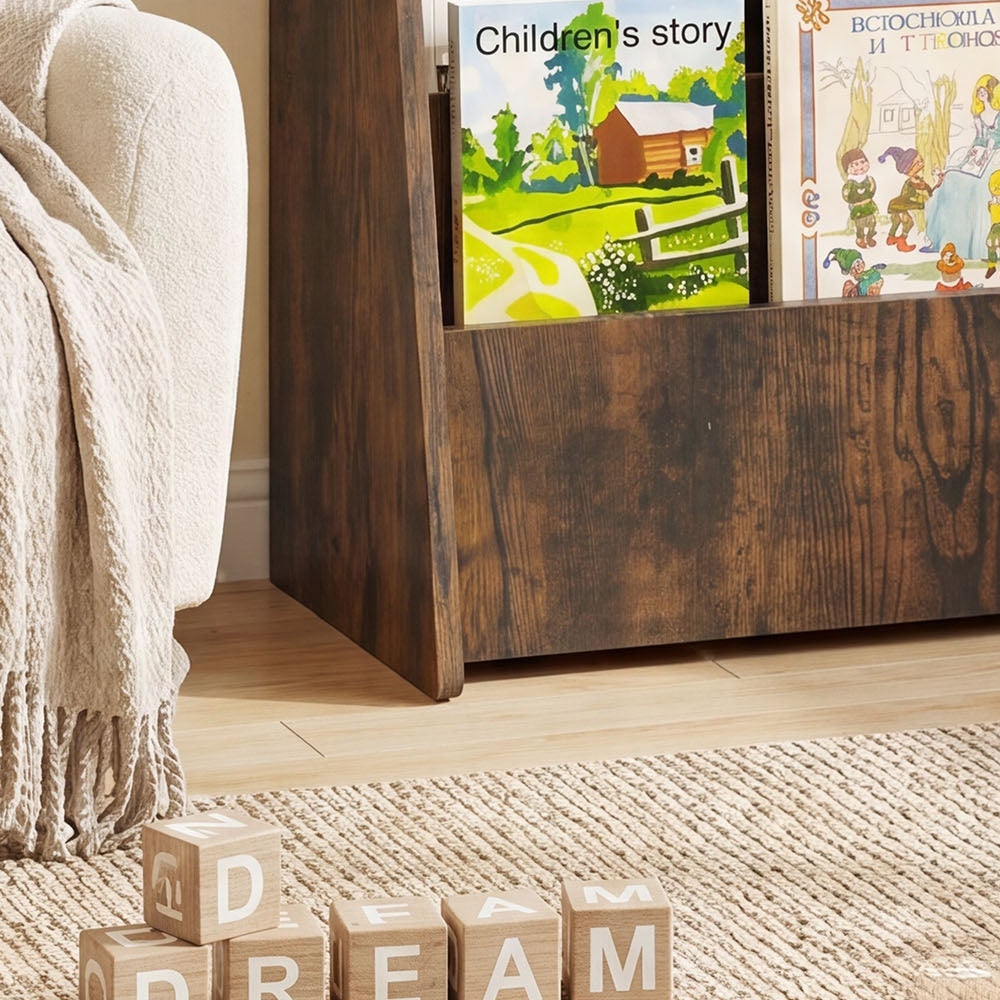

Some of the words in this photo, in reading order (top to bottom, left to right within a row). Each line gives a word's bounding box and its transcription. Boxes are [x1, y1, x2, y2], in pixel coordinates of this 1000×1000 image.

[475, 19, 639, 56] Children's
[651, 17, 733, 50] story
[217, 854, 264, 925] D
